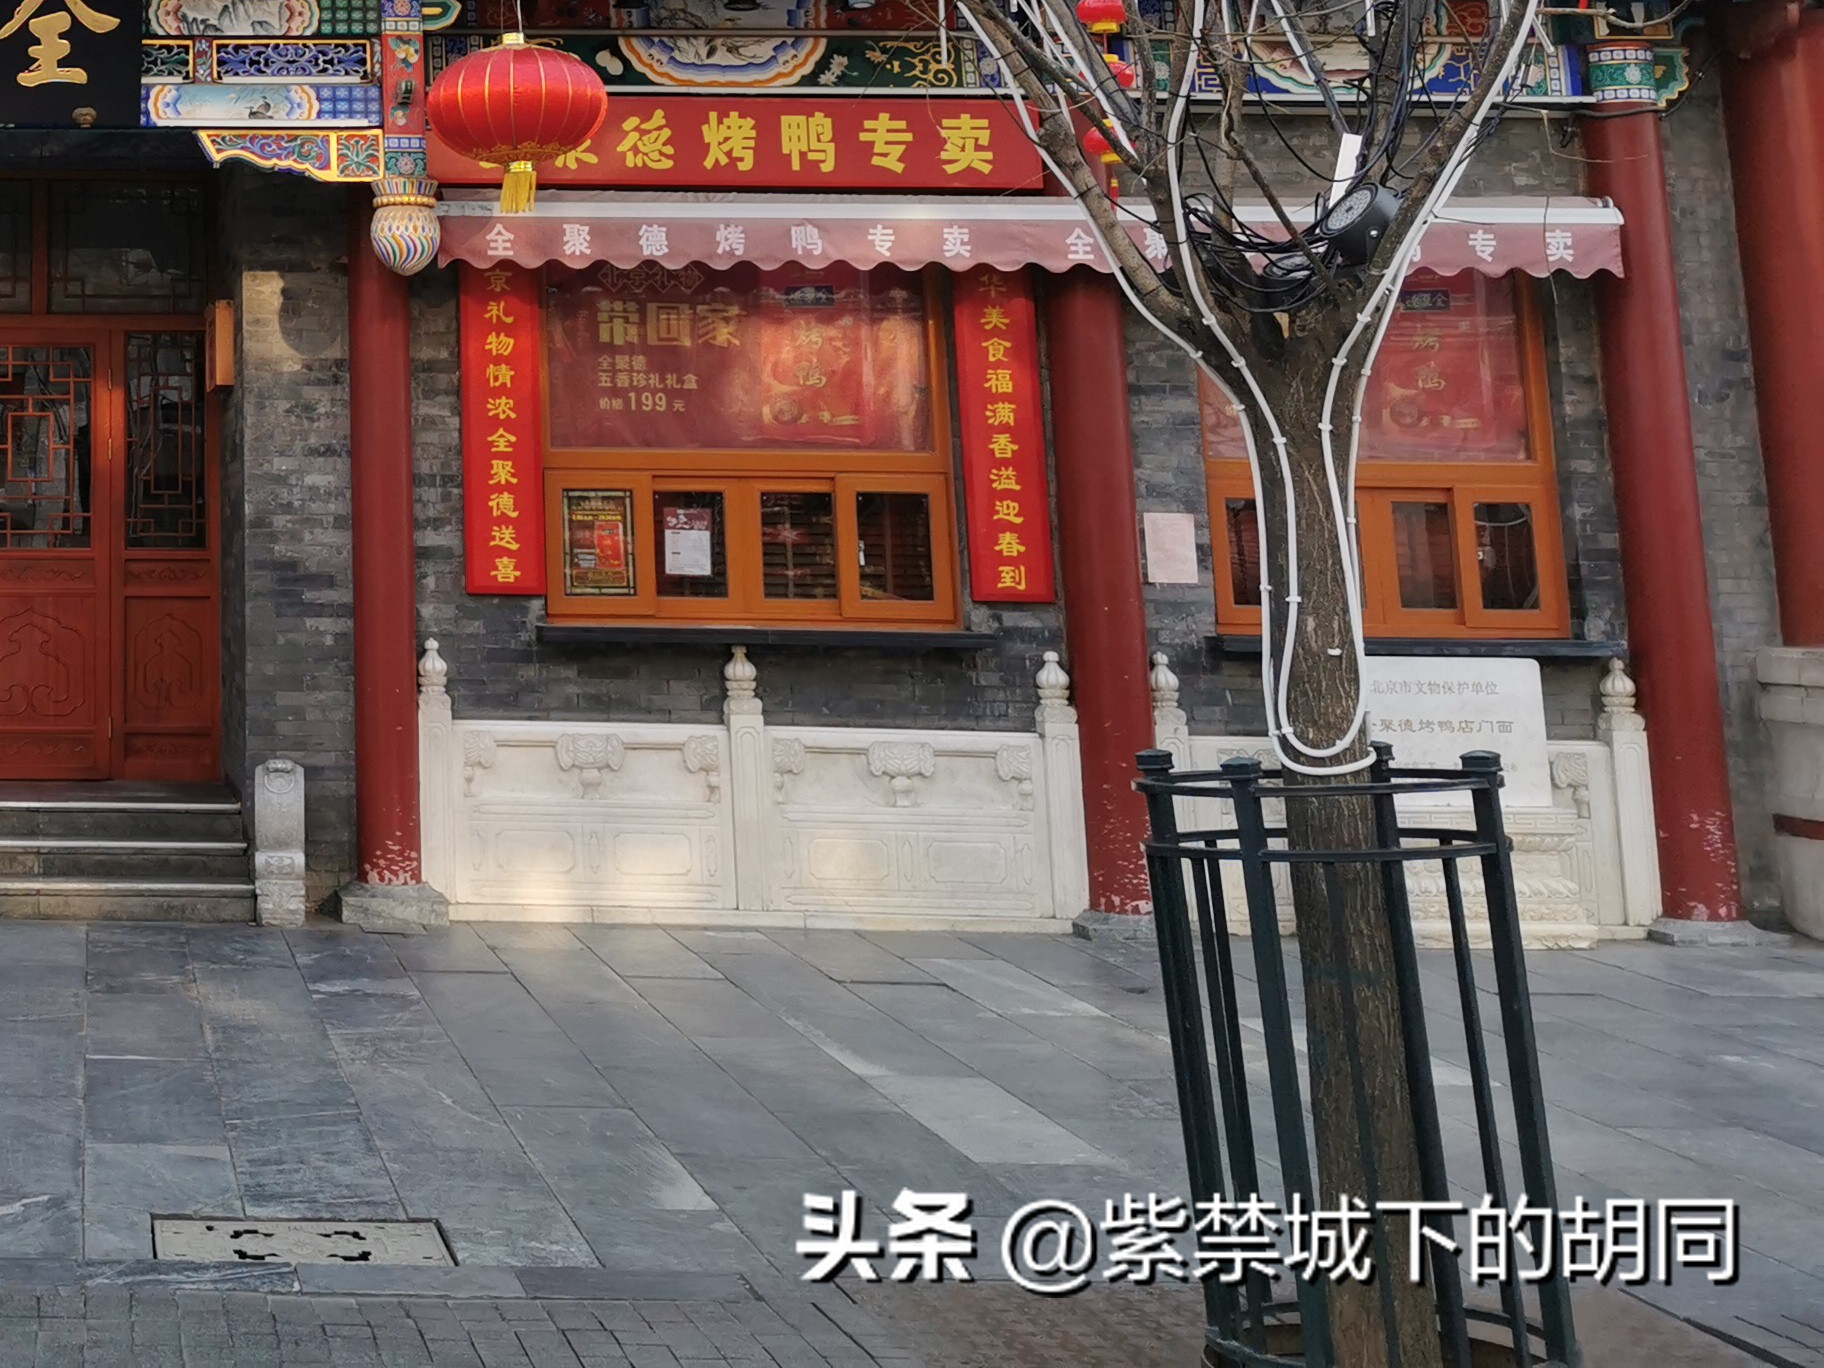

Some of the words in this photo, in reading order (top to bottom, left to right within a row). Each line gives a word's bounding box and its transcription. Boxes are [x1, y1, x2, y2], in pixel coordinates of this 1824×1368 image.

[478, 109, 994, 175] 德烤鸭专卖
[485, 223, 972, 258] 全聚德烤鸭专卖
[596, 300, 746, 347] 带回家
[597, 354, 648, 371] 全聚德
[1372, 717, 1516, 735] 聚德烤鸭店门面
